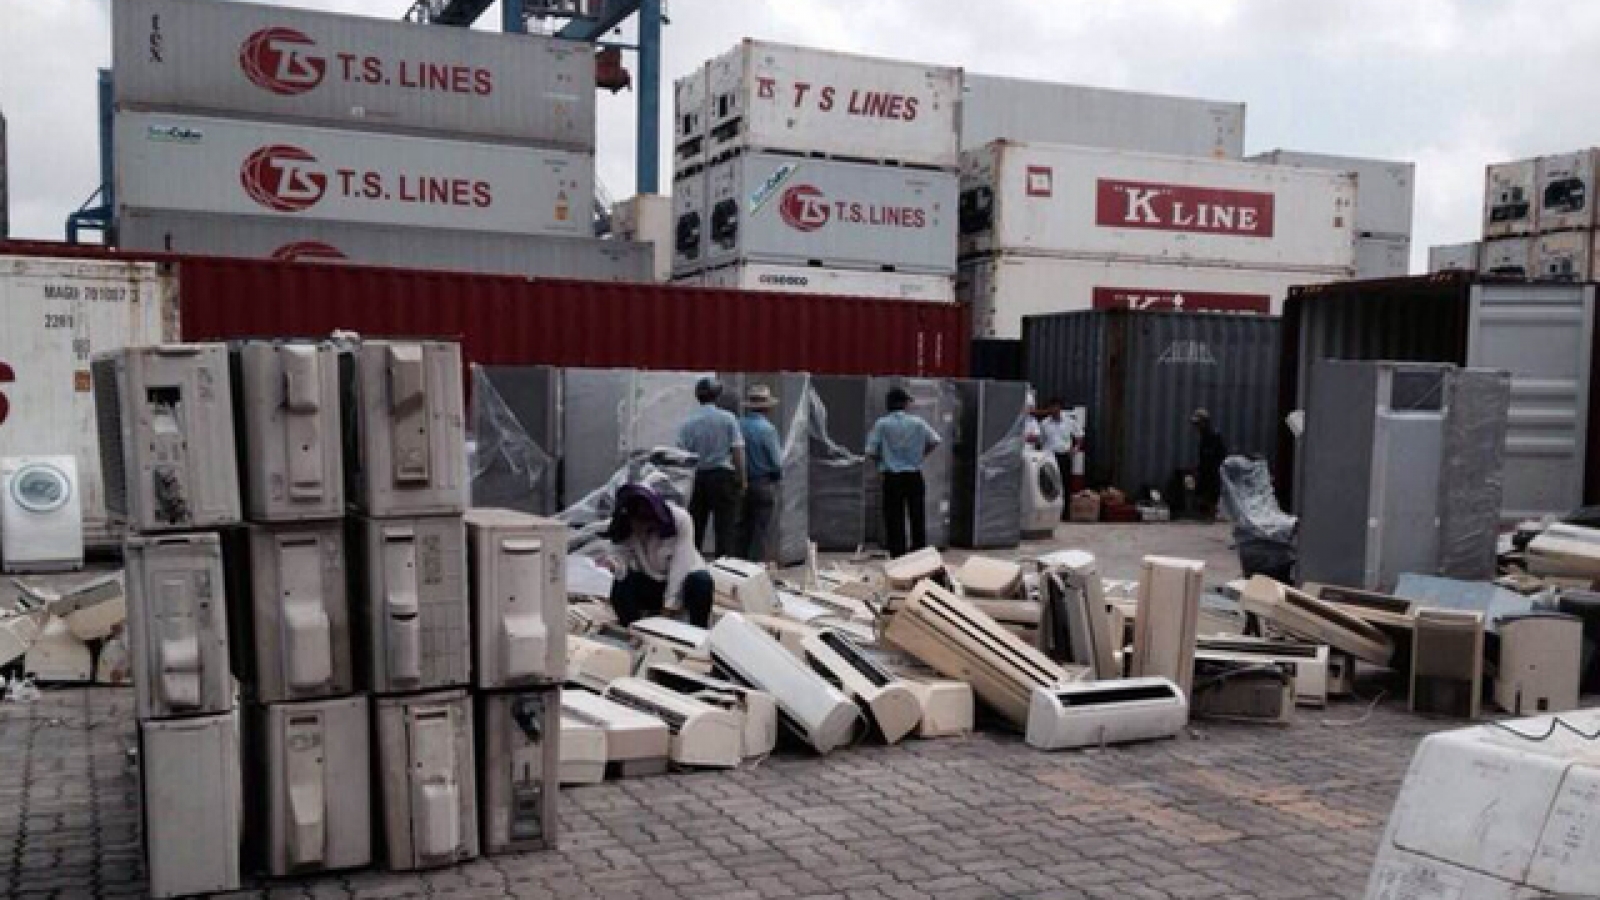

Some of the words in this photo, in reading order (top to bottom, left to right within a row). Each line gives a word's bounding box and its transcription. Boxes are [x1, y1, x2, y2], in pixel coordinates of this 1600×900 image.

[337, 53, 391, 86] T.S.
[400, 61, 492, 96] LINES
[794, 83, 810, 108] T
[819, 86, 836, 112] S
[847, 89, 920, 121] LINES
[337, 169, 391, 199] T.S.
[400, 176, 492, 208] LINES
[835, 201, 868, 224] T.S.
[869, 205, 926, 228] LINES
[1172, 201, 1258, 231] LINE
